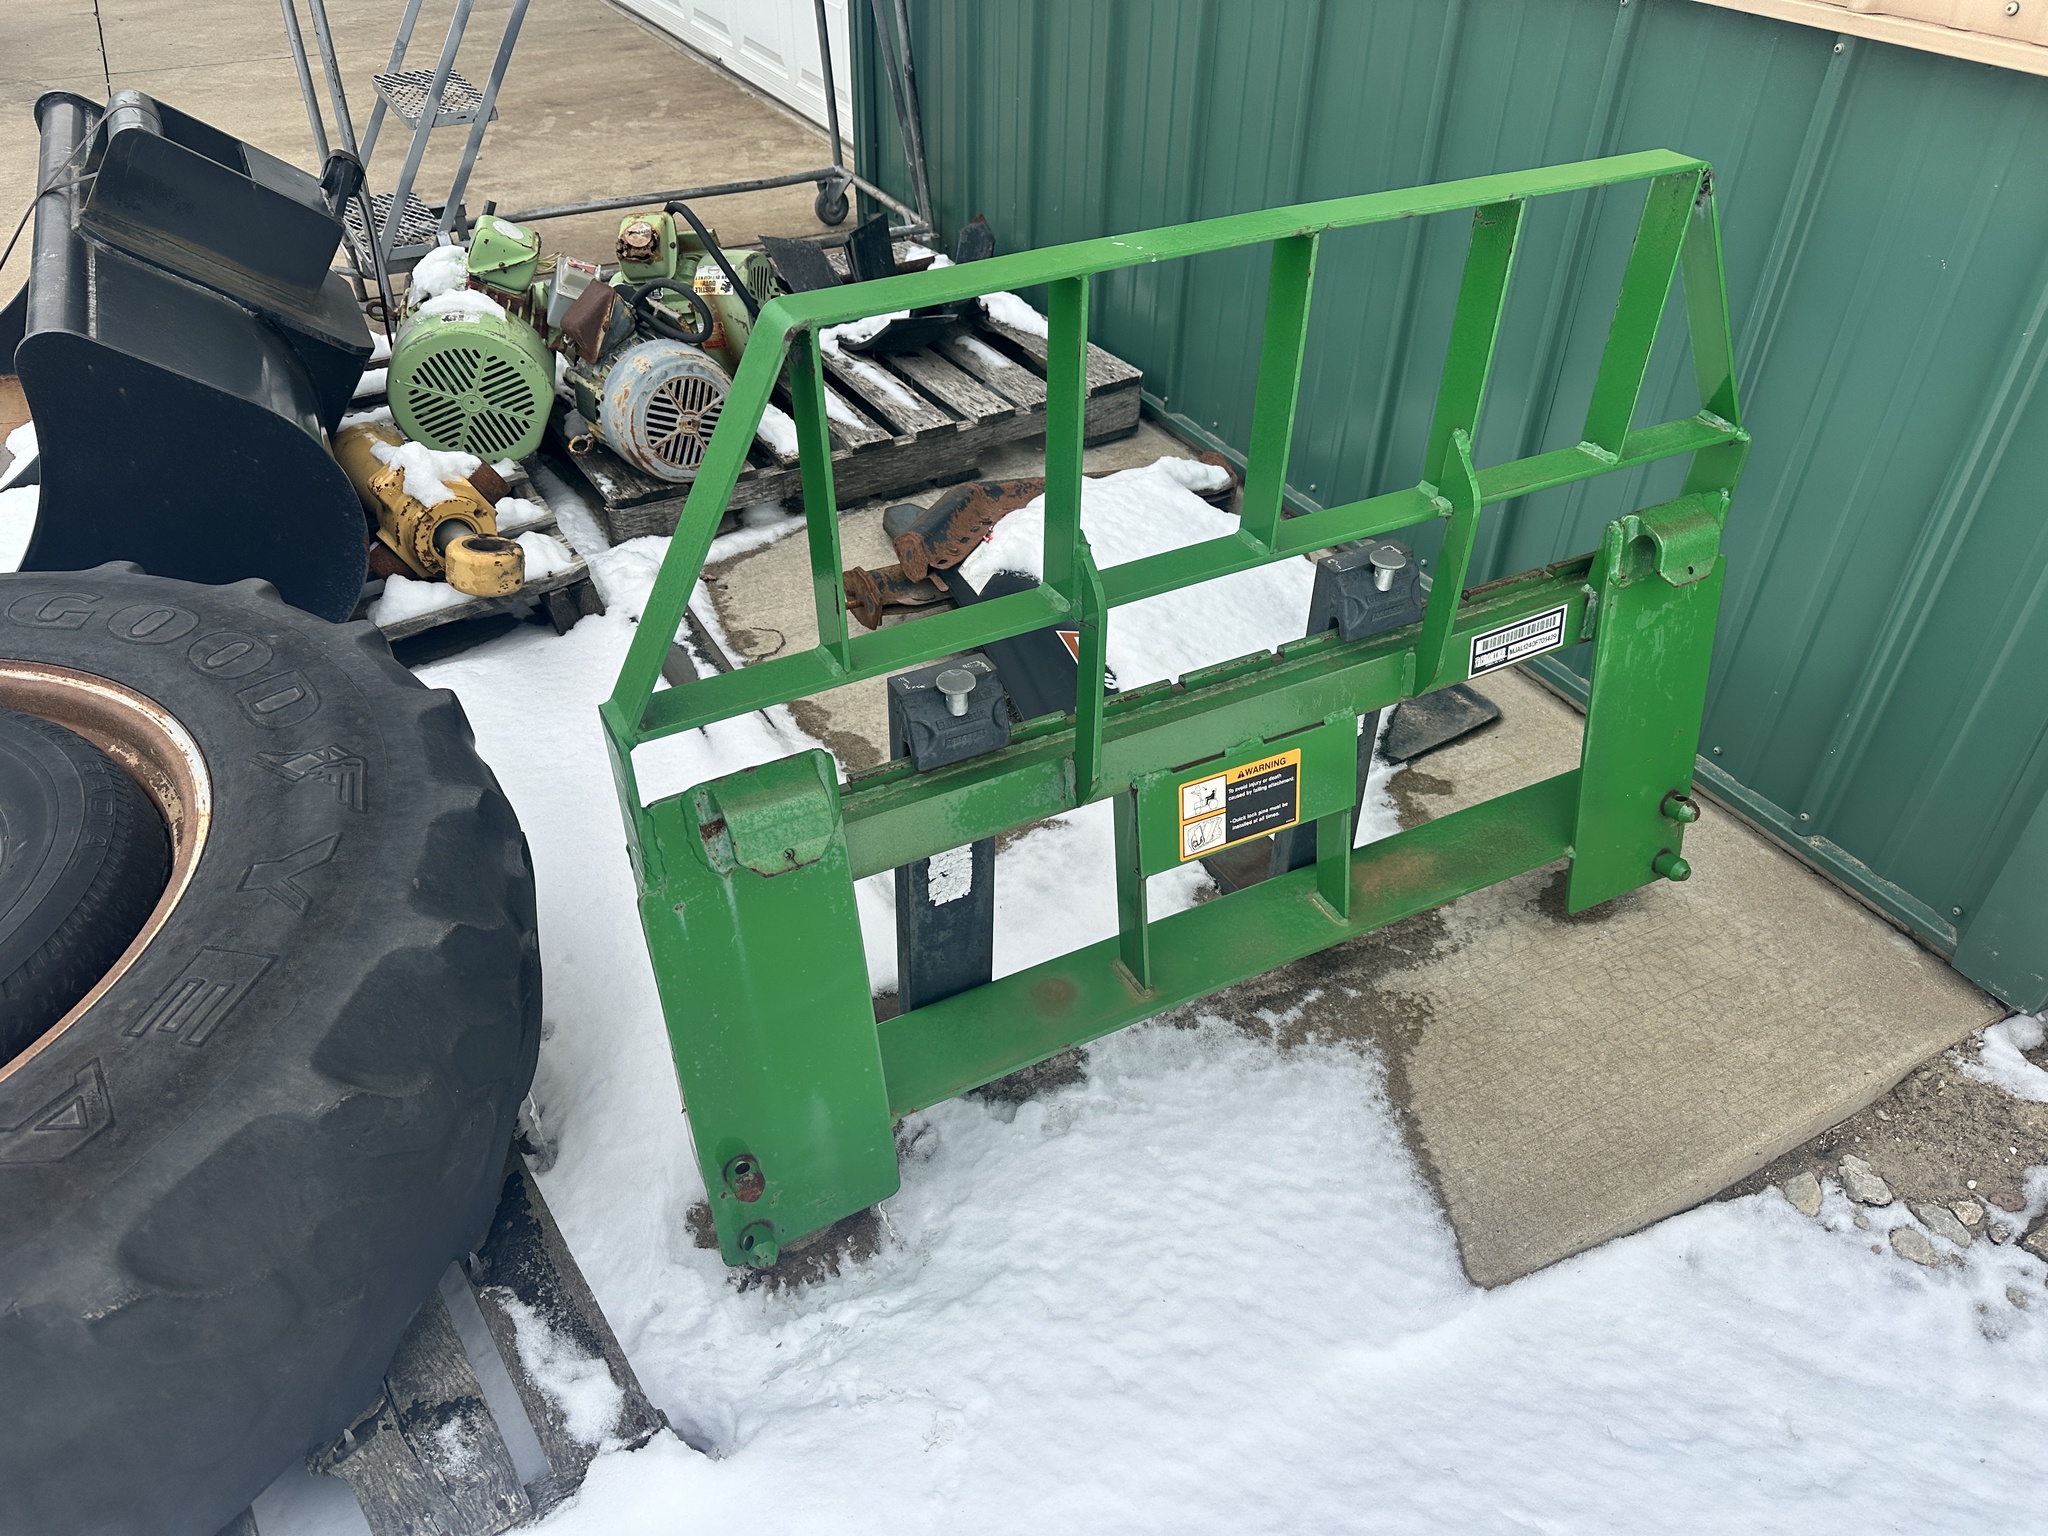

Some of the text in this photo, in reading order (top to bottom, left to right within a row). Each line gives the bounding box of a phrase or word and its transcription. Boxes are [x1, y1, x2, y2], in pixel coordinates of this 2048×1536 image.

[1245, 757, 1286, 776] WARNING
[1235, 784, 1248, 792] avoid
[1249, 780, 1262, 788] injury
[1268, 773, 1282, 782] death
[1228, 792, 1245, 801] caused
[1253, 785, 1267, 793] falling
[1247, 811, 1257, 819] lock
[1258, 808, 1268, 816] pins
[1269, 803, 1281, 812] must
[1232, 820, 1252, 831] installed
